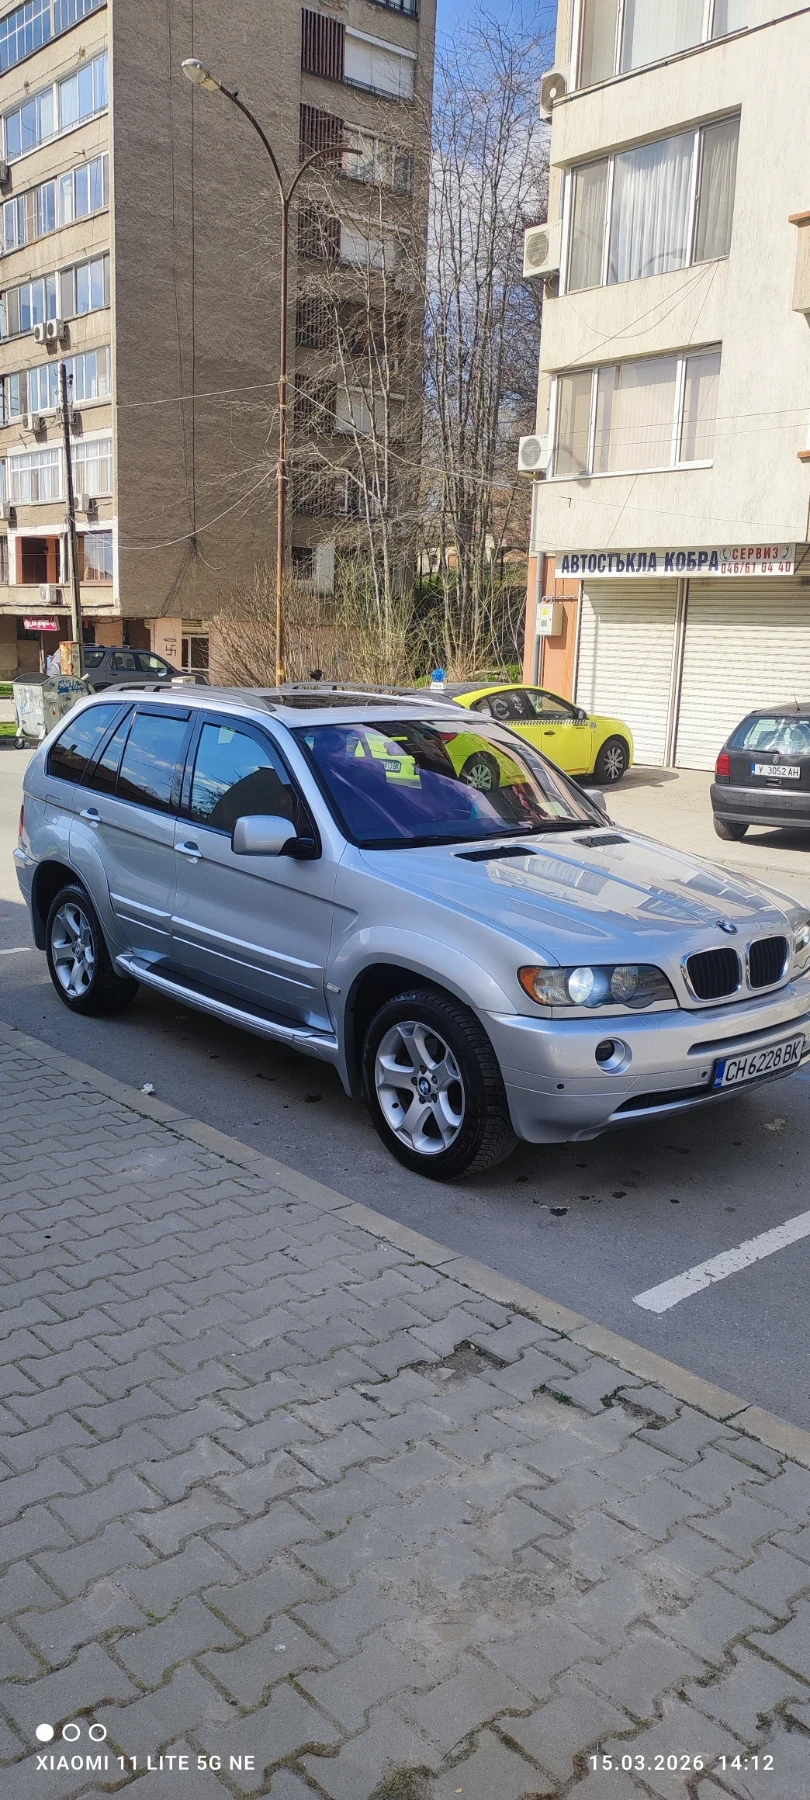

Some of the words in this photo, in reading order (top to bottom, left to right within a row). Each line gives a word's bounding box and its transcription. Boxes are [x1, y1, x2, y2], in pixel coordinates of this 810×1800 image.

[561, 552, 657, 574] АВТОСТЪКЛА
[664, 550, 719, 573] КОБРА
[732, 546, 779, 560] СЕРВИЗ
[720, 561, 756, 575] 046/61
[761, 561, 774, 574] 04
[778, 561, 792, 573] 40
[748, 1047, 782, 1076] 6228
